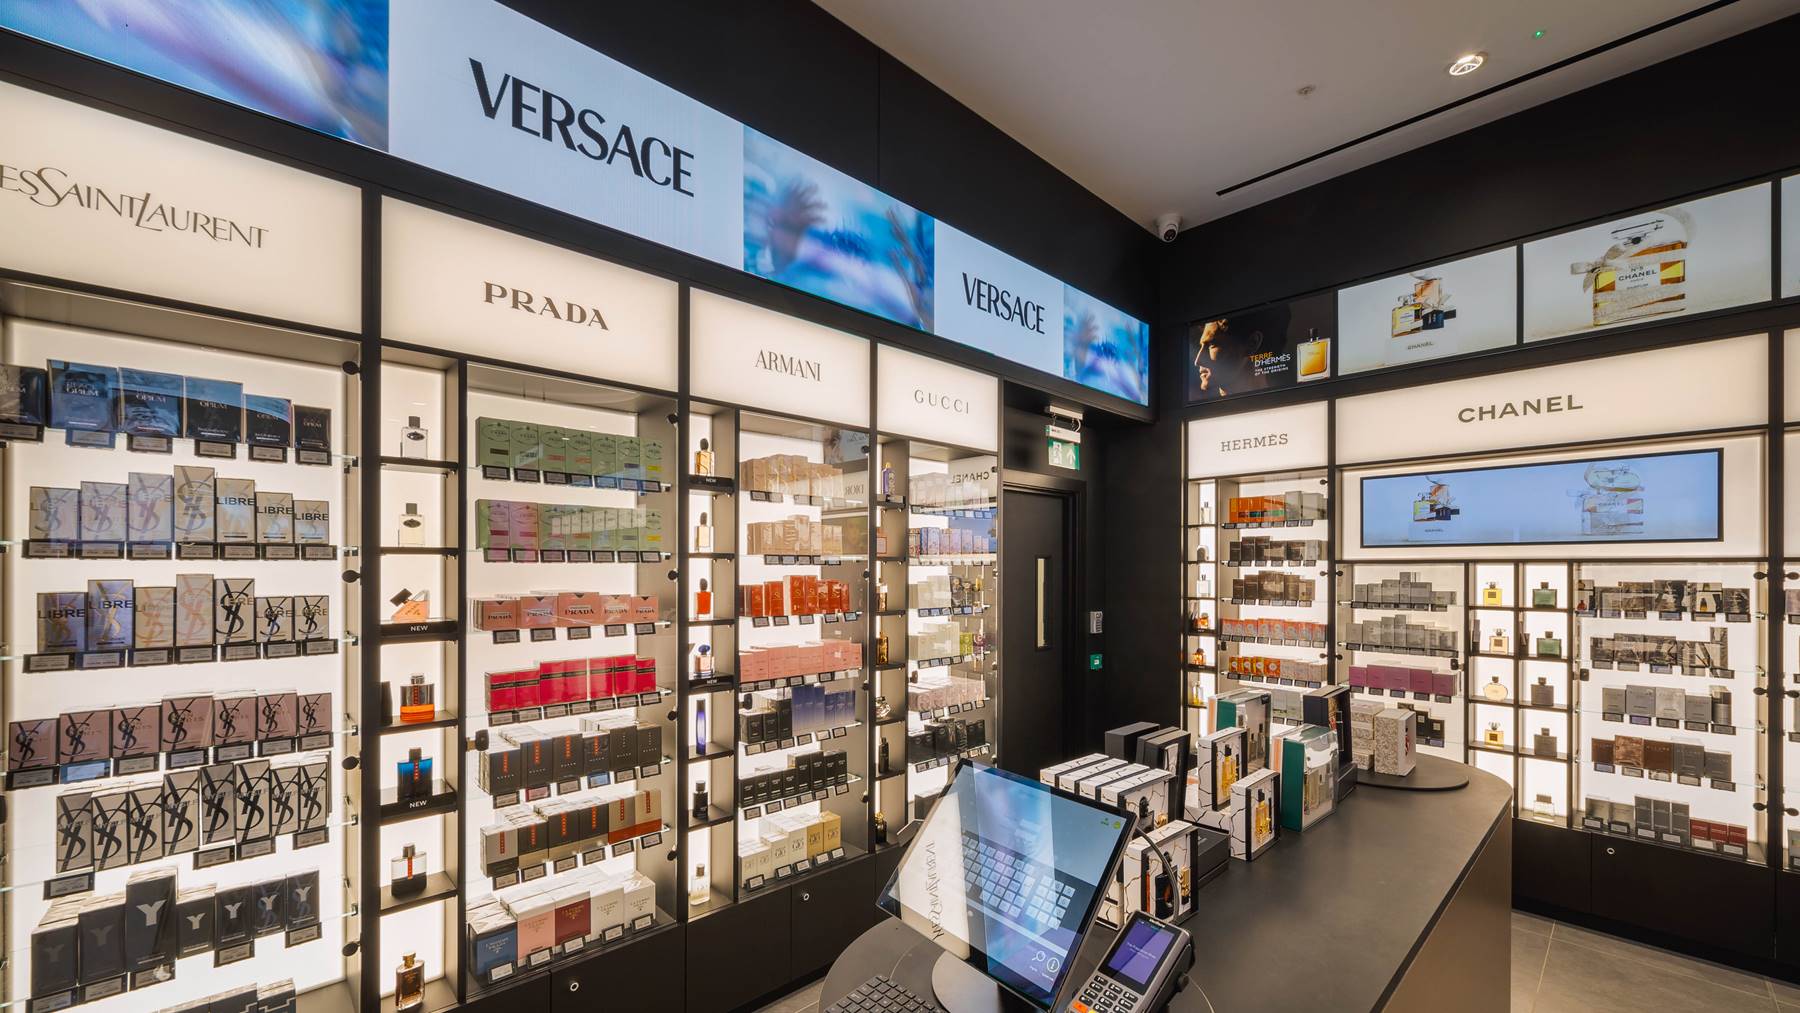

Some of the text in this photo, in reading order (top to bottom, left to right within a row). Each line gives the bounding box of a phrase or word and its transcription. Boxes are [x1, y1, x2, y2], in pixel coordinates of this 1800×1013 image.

[469, 57, 694, 197] VERSACE
[1618, 270, 1657, 281] CHANEL
[484, 281, 609, 330] PRADA
[962, 272, 1045, 334] VERSACE
[755, 349, 821, 381] ARMANI
[1250, 352, 1273, 362] TERRE
[914, 389, 969, 414] GUCCI
[1458, 394, 1584, 423] CHANEL
[1221, 433, 1288, 452] HERMÈS
[217, 497, 255, 506] LIBRE
[257, 506, 294, 515] LIBRE
[295, 512, 329, 521] LIBRE
[38, 609, 86, 619] LIBRE
[409, 800, 427, 808] NEW
[261, 895, 278, 910] Y
[295, 886, 312, 902] Y
[136, 899, 167, 926] Y
[224, 902, 243, 919] Y
[186, 913, 206, 930] Y
